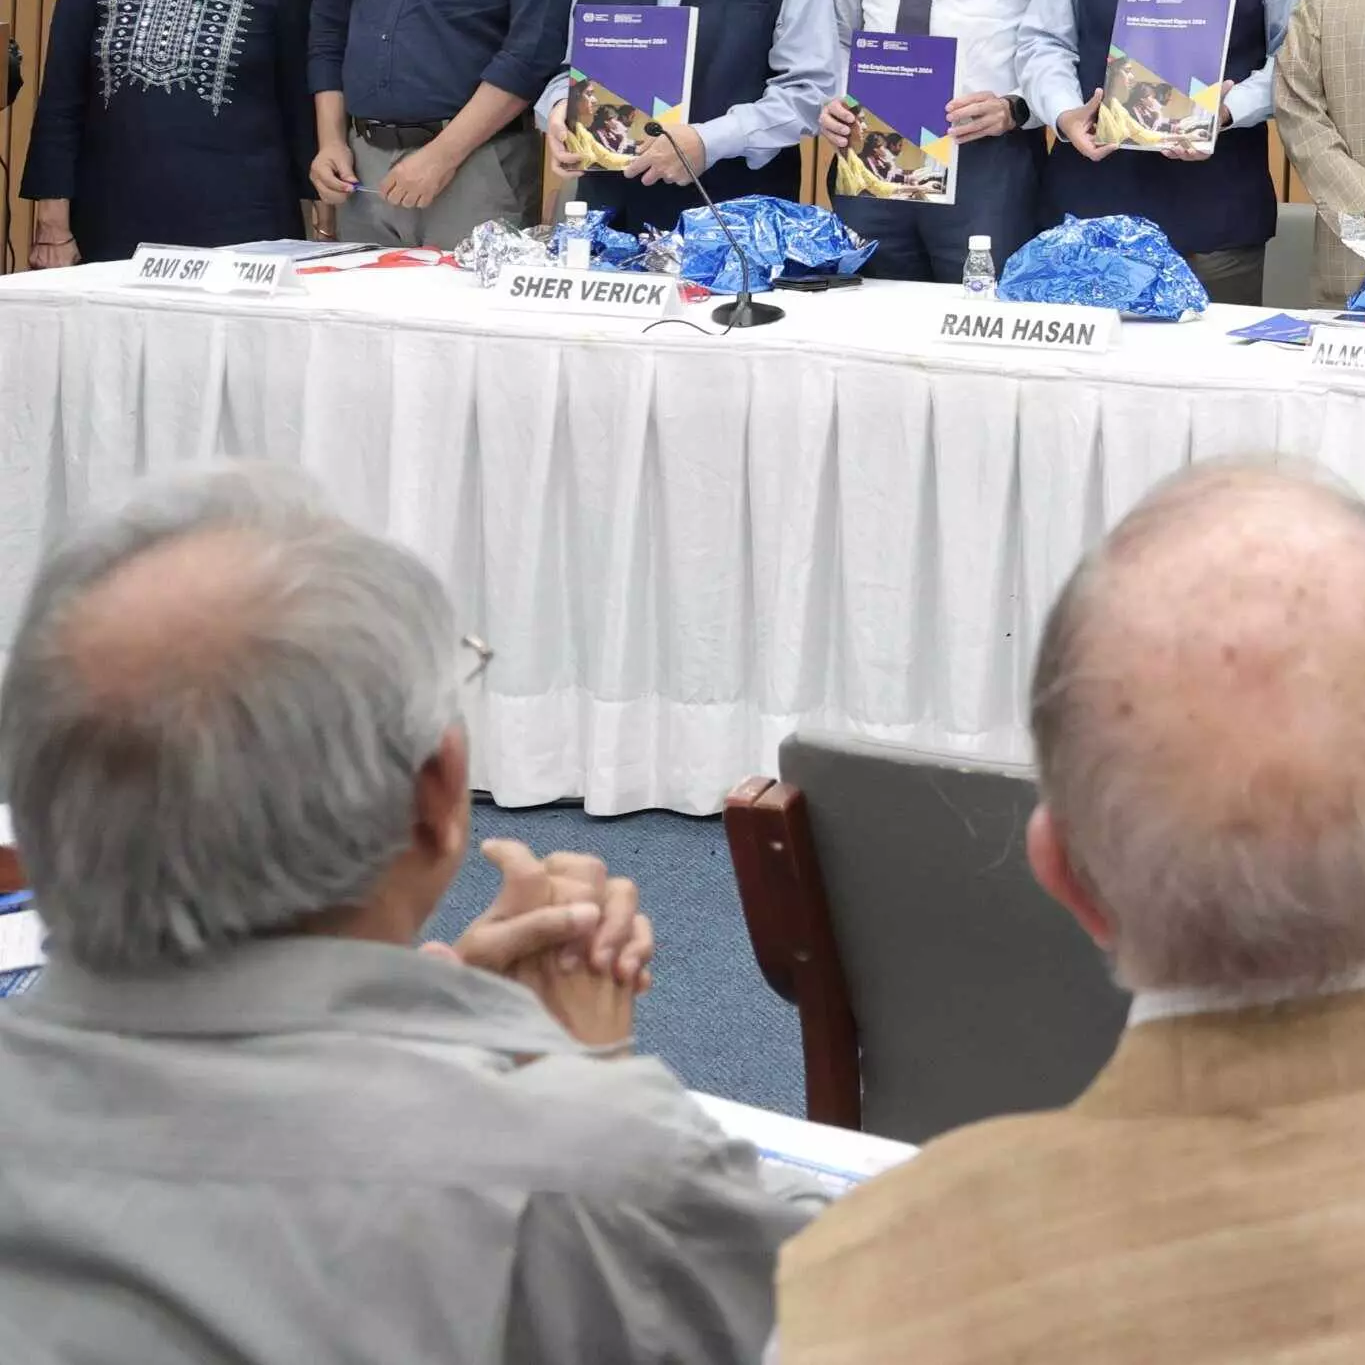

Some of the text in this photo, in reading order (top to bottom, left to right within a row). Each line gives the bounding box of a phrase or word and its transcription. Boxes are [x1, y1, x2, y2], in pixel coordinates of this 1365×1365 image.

[140, 256, 277, 285] RAVI SRITAVA
[510, 275, 667, 305] SHER VERICK
[940, 313, 1096, 346] RANA HASAN
